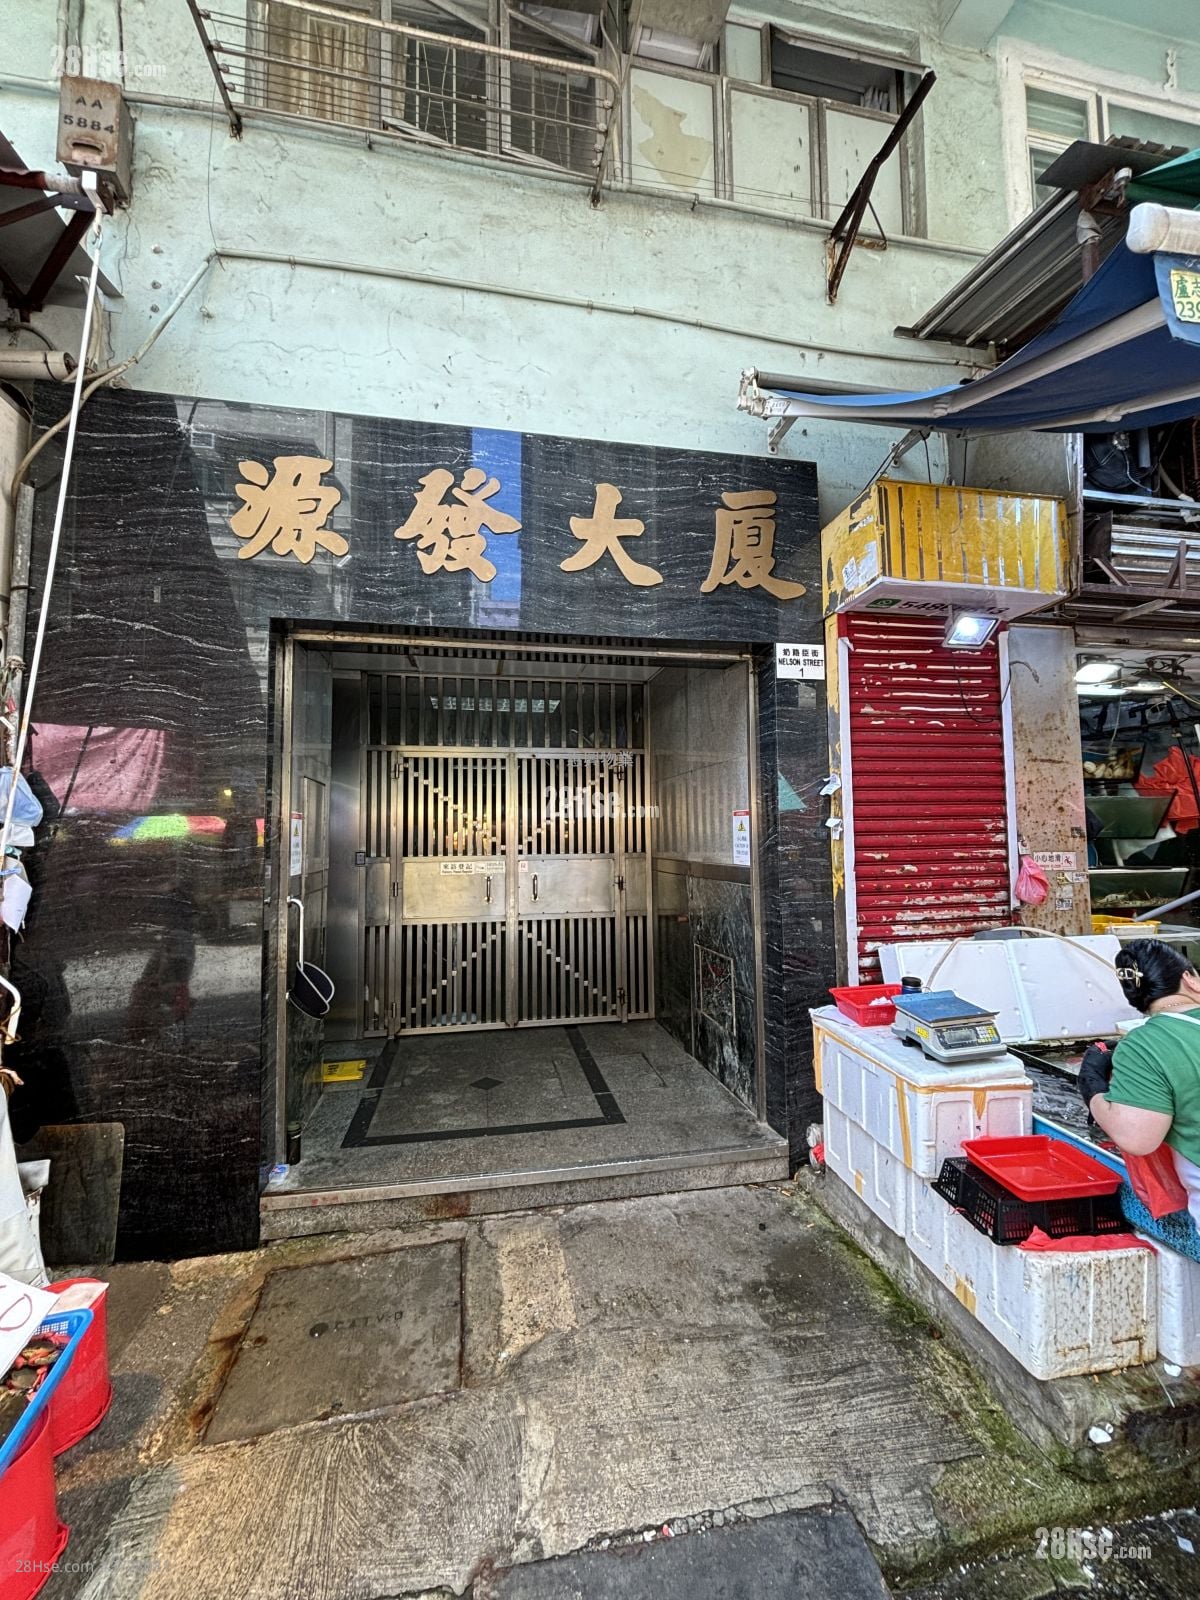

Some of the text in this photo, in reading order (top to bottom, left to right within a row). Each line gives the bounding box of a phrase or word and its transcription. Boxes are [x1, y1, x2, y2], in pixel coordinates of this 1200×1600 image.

[76, 95, 103, 110] AA
[63, 114, 115, 134] 5884
[778, 658, 824, 667] NELSON STREET
[799, 667, 804, 678] 1
